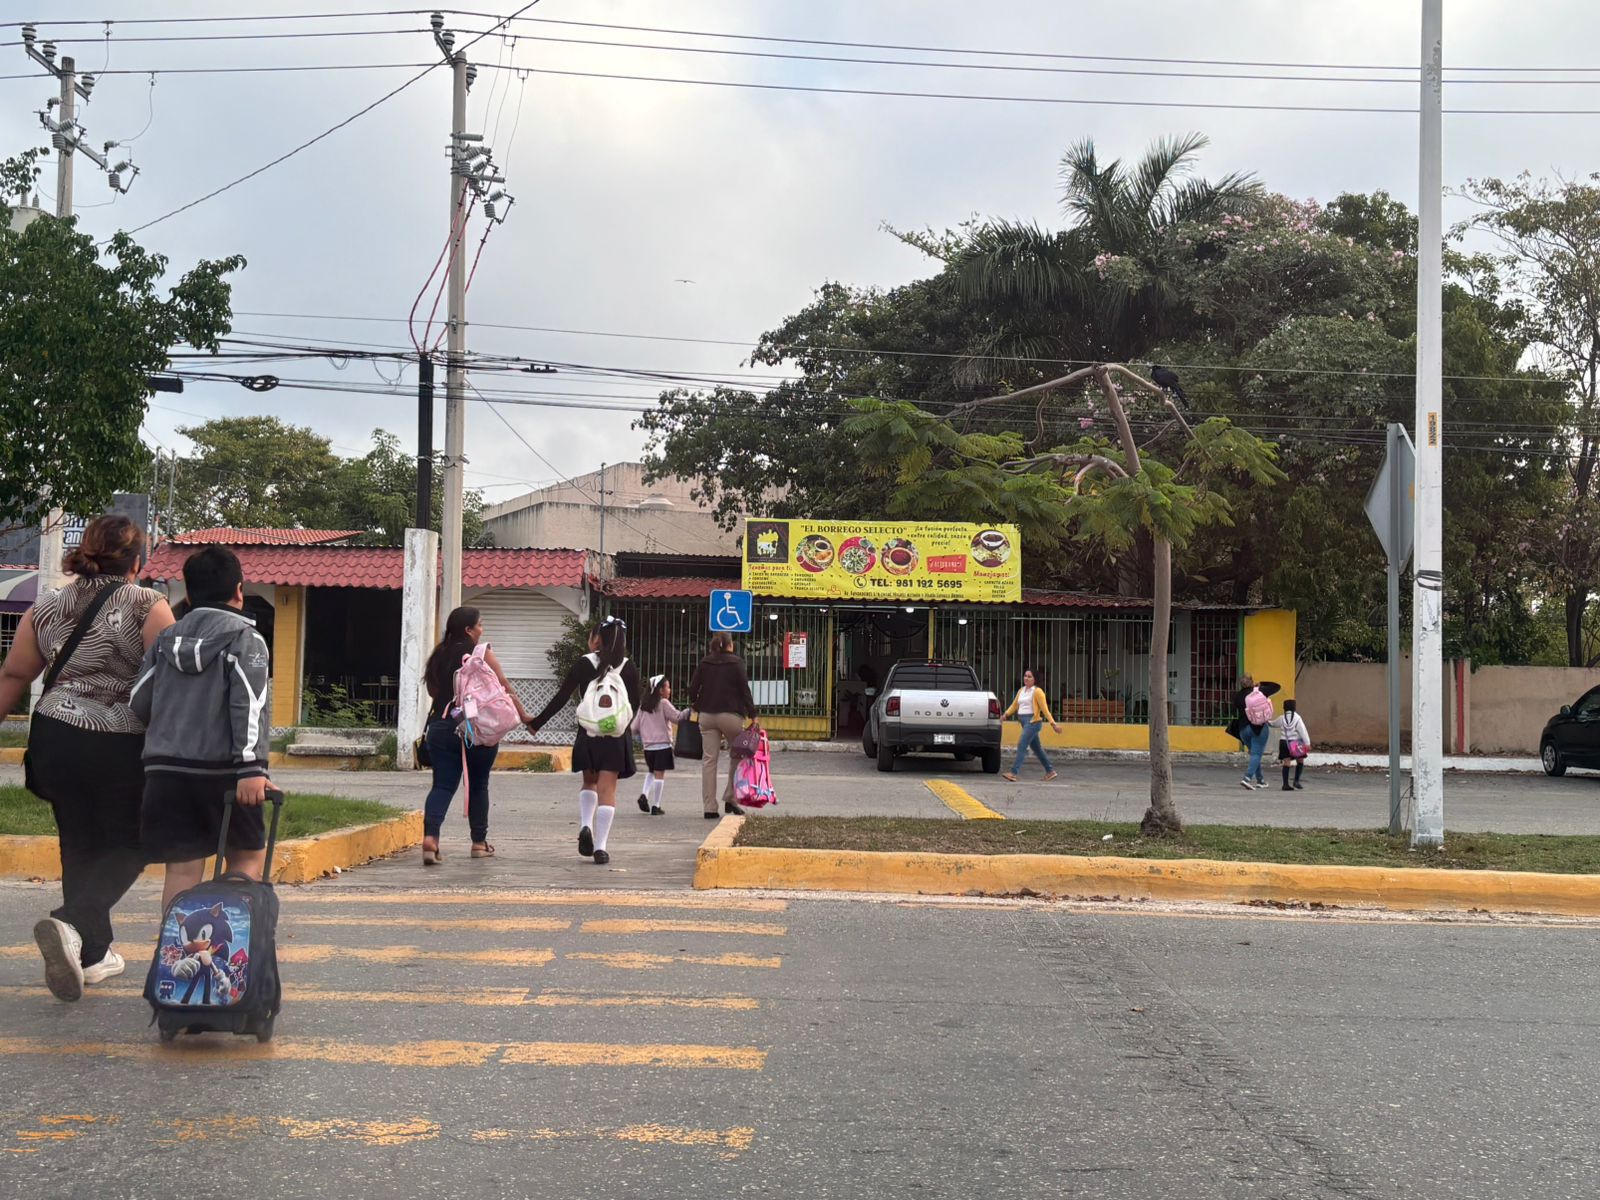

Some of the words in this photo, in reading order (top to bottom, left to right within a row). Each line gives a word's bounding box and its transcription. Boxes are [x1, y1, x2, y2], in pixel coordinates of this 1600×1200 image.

[817, 525, 861, 533] BORREGO
[863, 526, 907, 534] SELECTO"
[870, 578, 892, 586] TEL:
[896, 579, 912, 587] 981
[917, 580, 933, 588] 192
[937, 580, 962, 588] 5695
